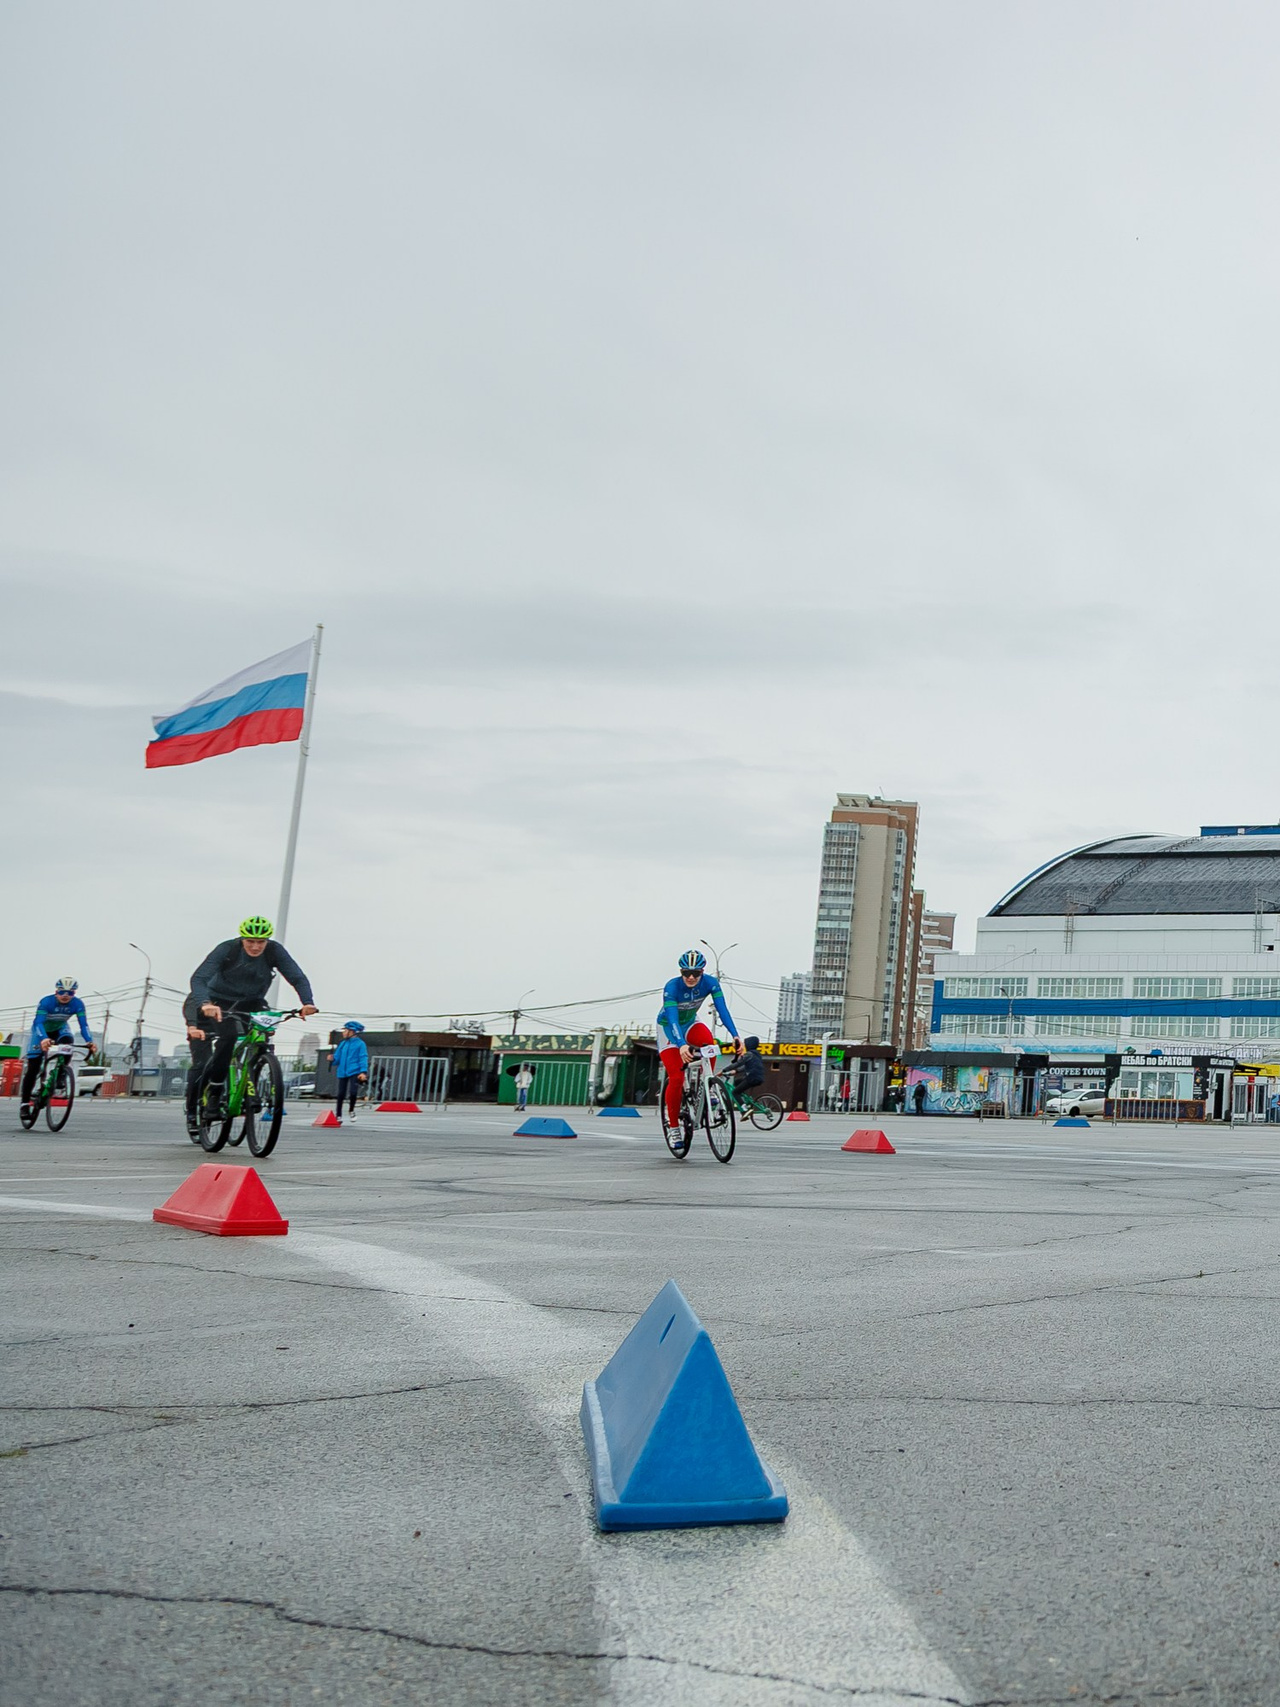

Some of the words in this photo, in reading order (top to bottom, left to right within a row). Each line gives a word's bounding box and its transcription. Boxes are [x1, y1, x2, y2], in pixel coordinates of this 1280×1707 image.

[1121, 1056, 1146, 1066] КЕБАБ
[1157, 1056, 1193, 1066] БРАТСКИ
[1049, 1066, 1081, 1076] COFFEE
[1082, 1066, 1107, 1076] TOWN
